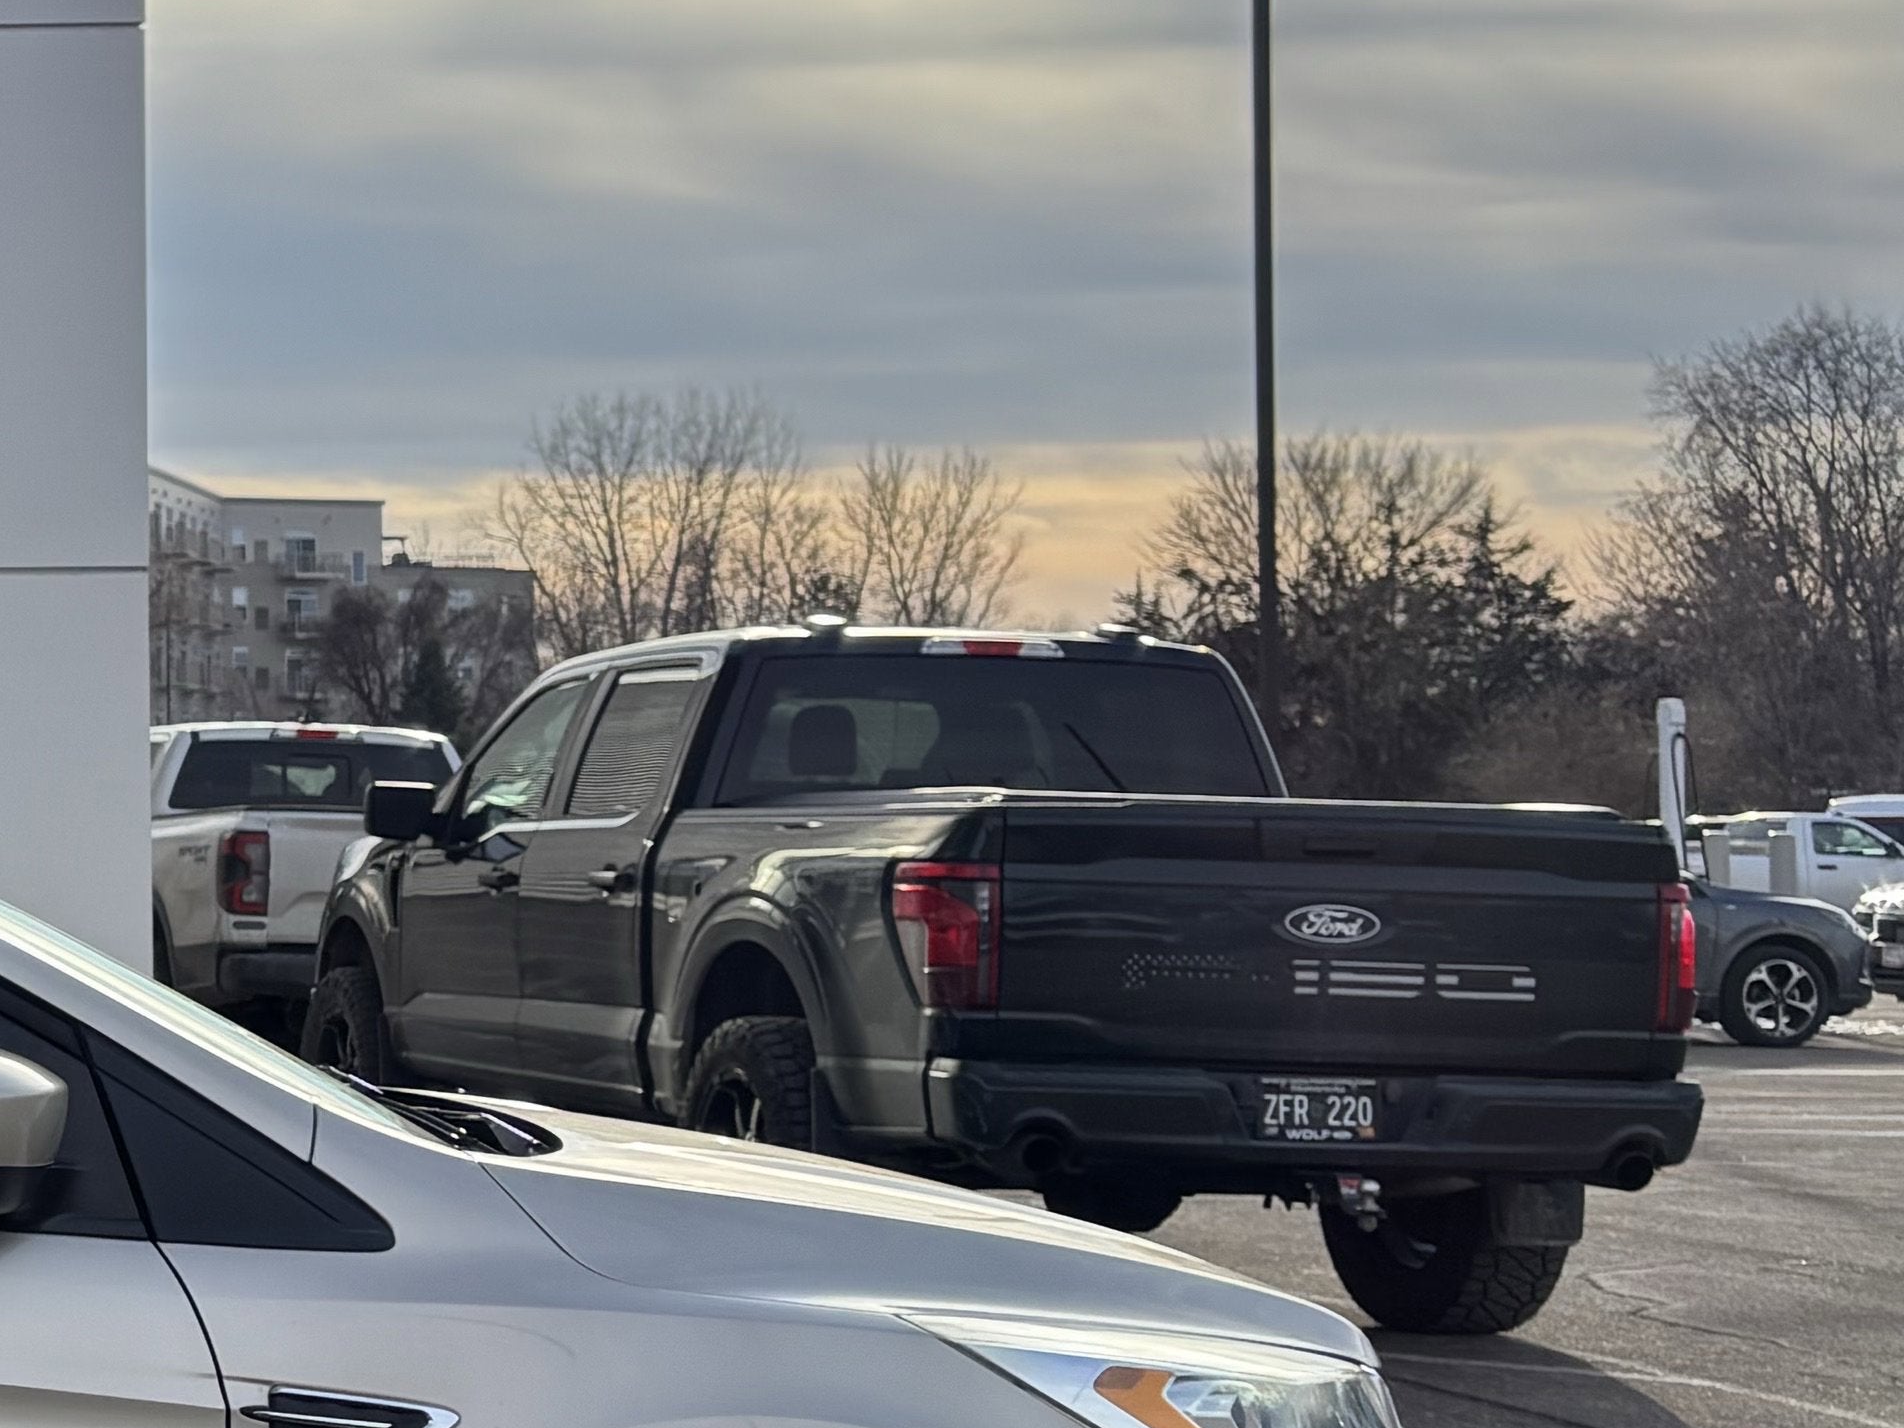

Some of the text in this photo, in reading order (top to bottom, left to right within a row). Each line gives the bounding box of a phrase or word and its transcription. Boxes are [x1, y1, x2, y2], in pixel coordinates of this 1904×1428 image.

[1298, 909, 1365, 939] Ford
[1263, 1093, 1373, 1127] ZFR 220
